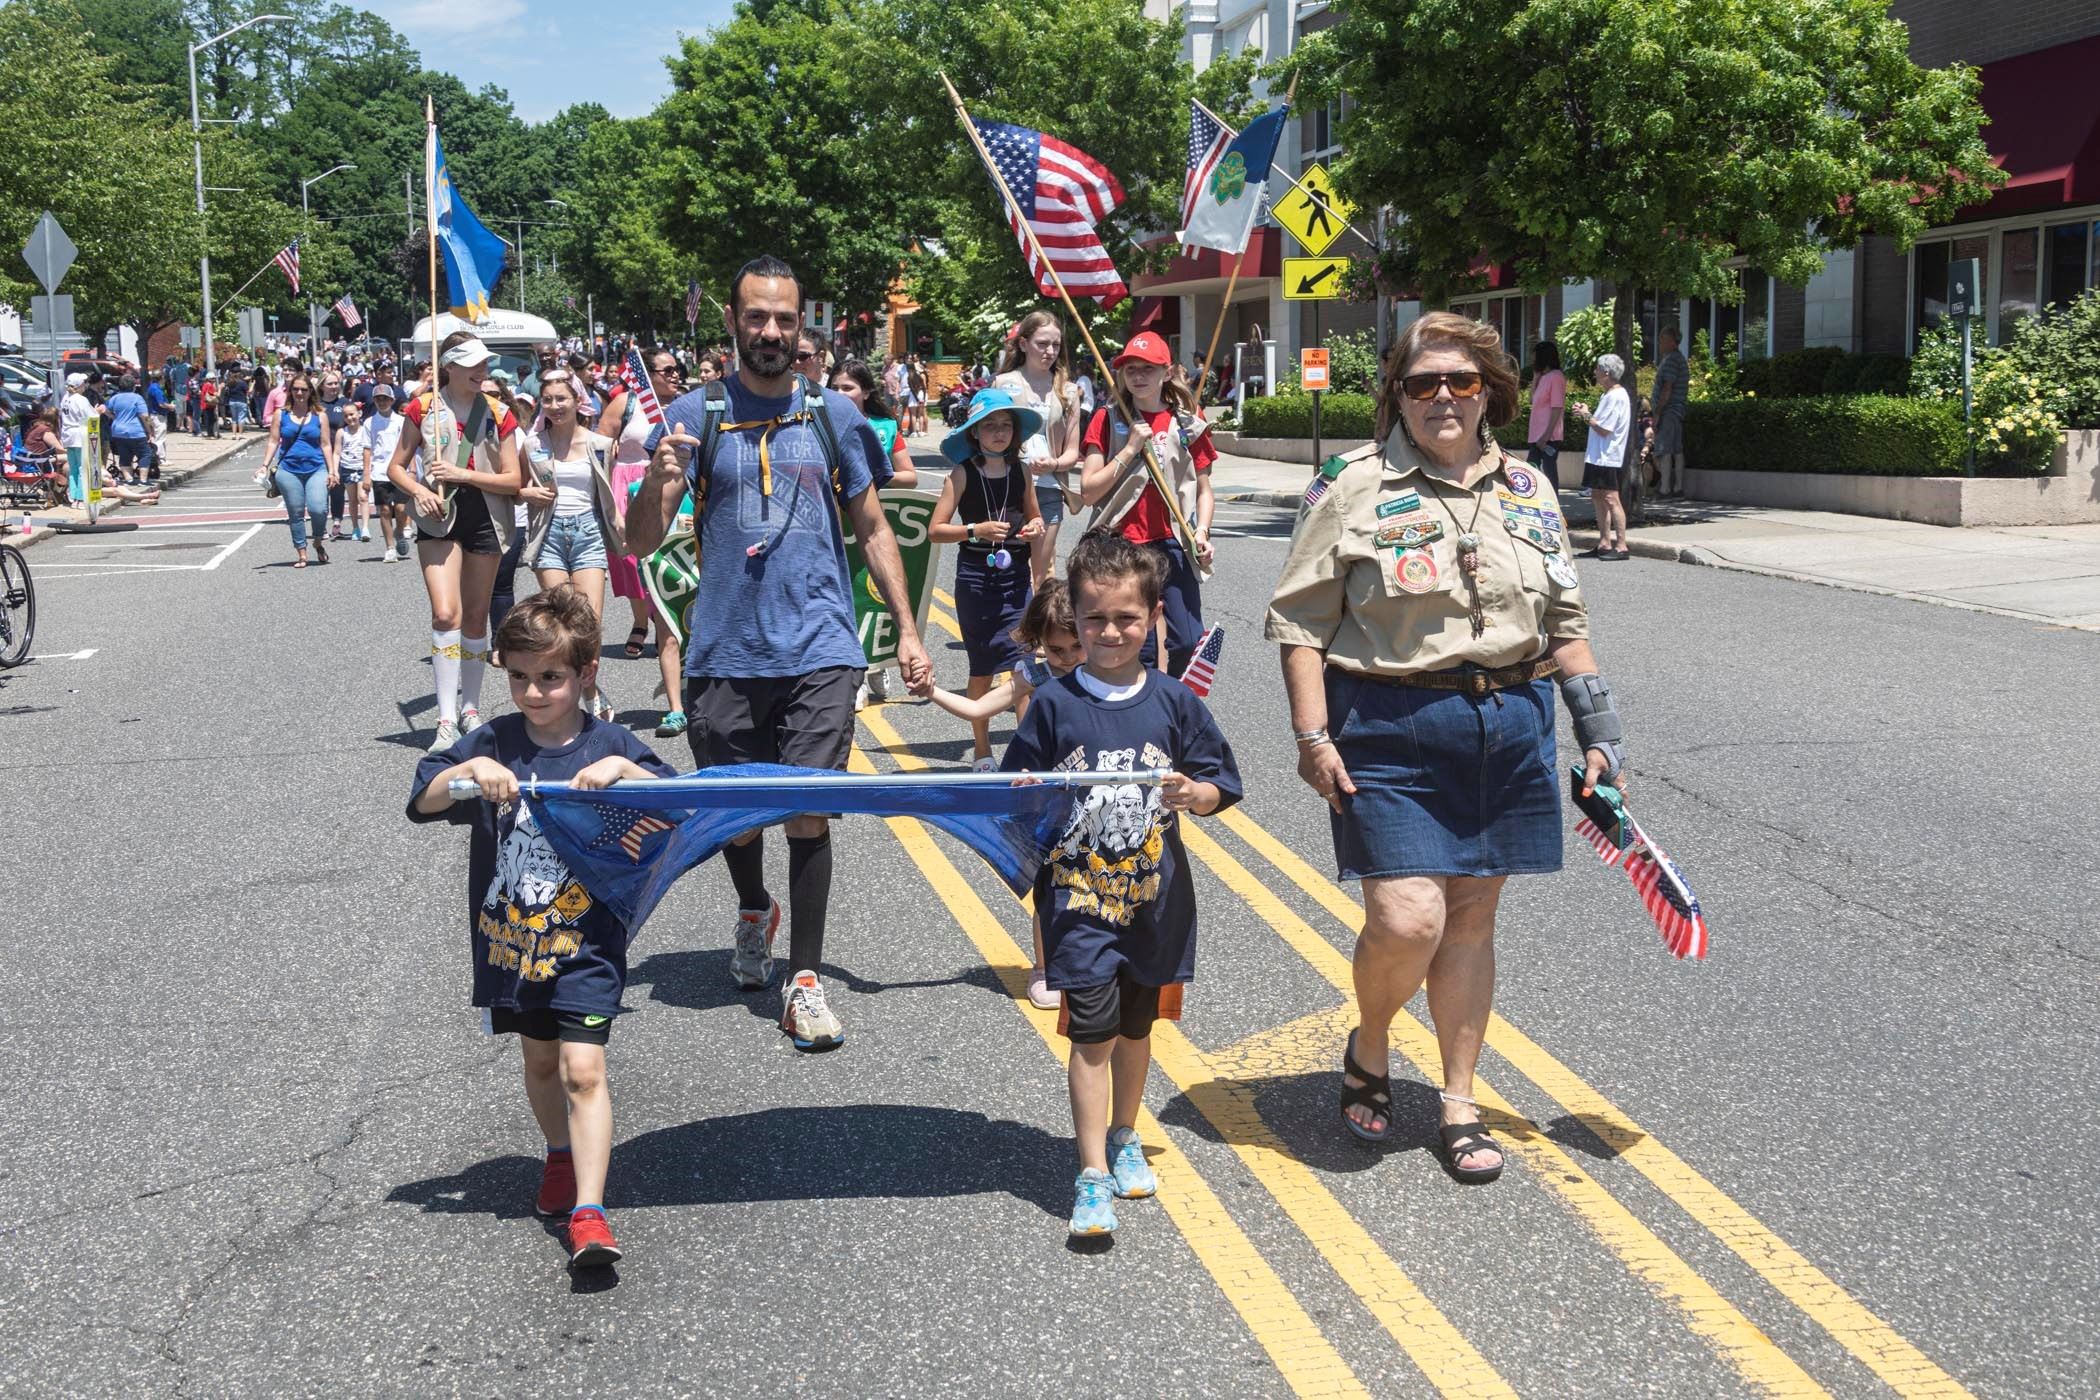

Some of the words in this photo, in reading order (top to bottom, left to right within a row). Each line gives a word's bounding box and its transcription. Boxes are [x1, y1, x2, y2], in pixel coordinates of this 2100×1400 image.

[1133, 337, 1148, 350] GC
[782, 440, 820, 459] YOR
[1051, 863, 1128, 898] RUNNING
[1067, 888, 1099, 916] THE
[488, 941, 520, 970] THE
[537, 928, 584, 958] WITH
